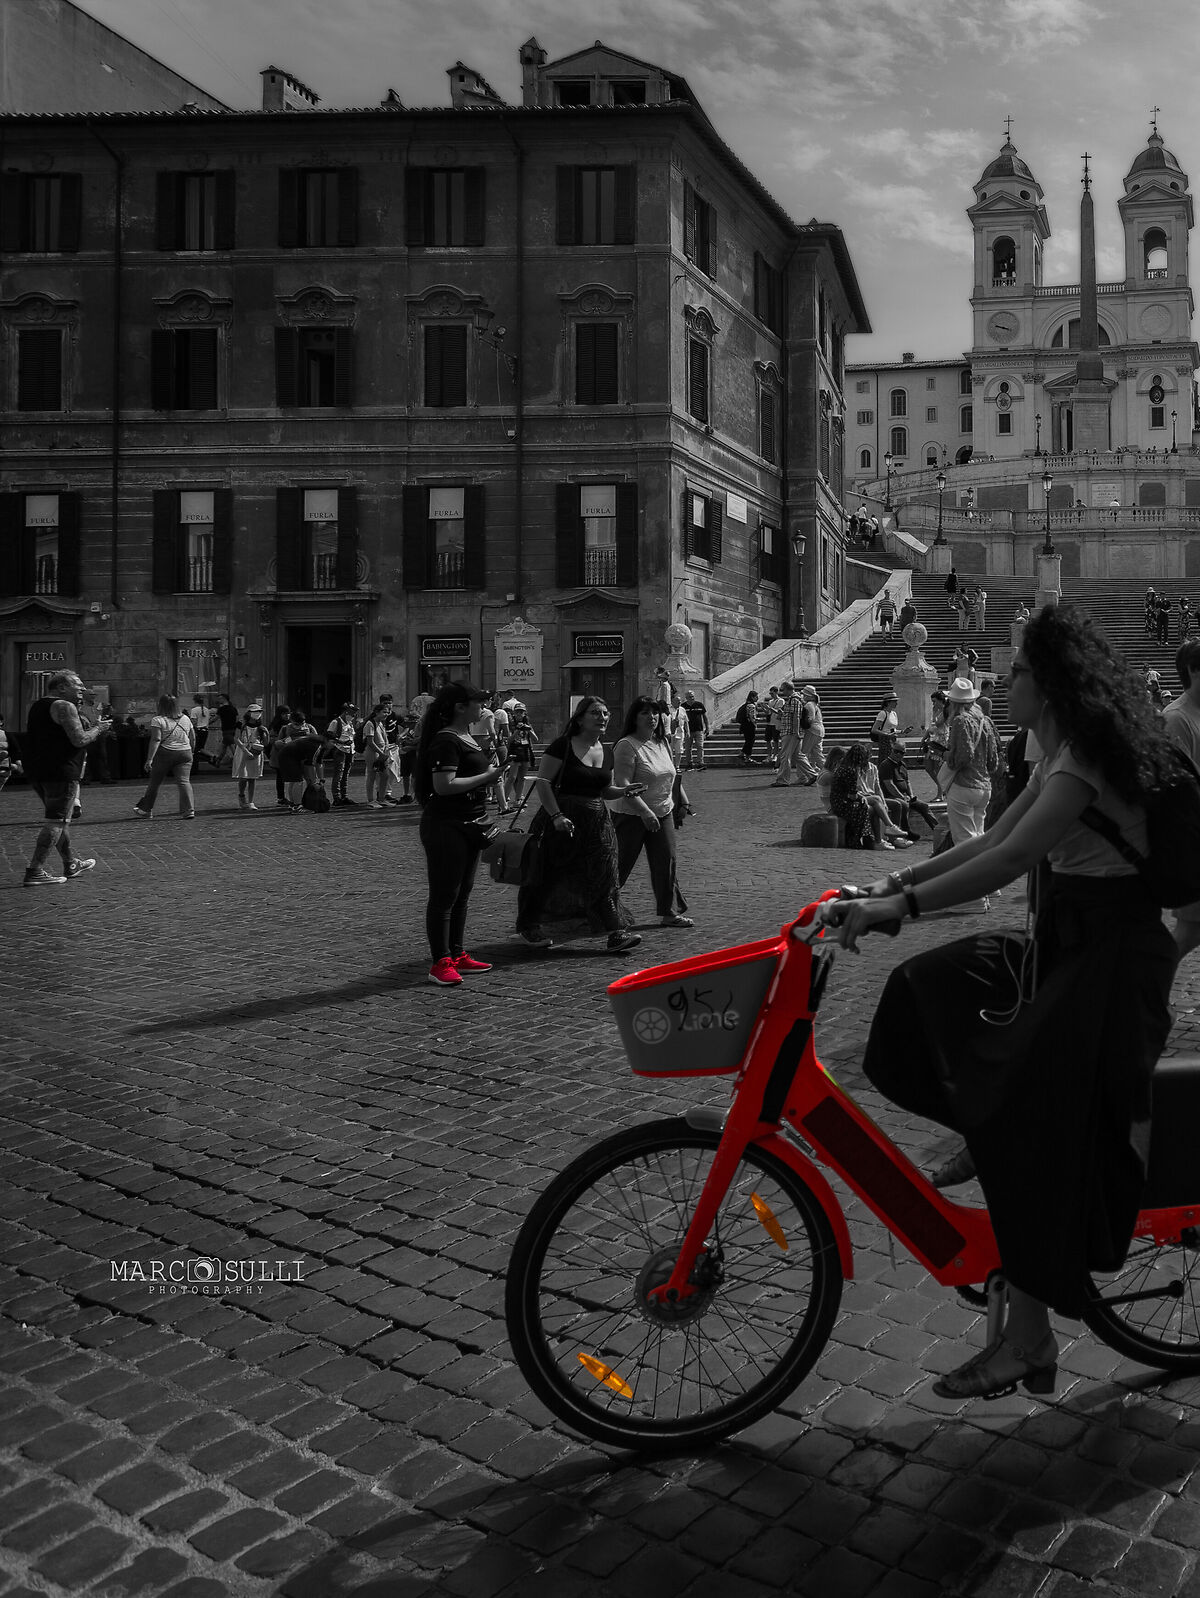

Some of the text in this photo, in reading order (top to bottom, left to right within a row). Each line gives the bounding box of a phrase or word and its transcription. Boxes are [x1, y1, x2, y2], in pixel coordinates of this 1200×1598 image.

[25, 652, 65, 661] FURLA
[179, 649, 219, 658] FURLA
[509, 655, 529, 664] TEA
[503, 668, 535, 677] ROOMS
[679, 1010, 741, 1032] Lime
[1134, 1218, 1153, 1230] ric
